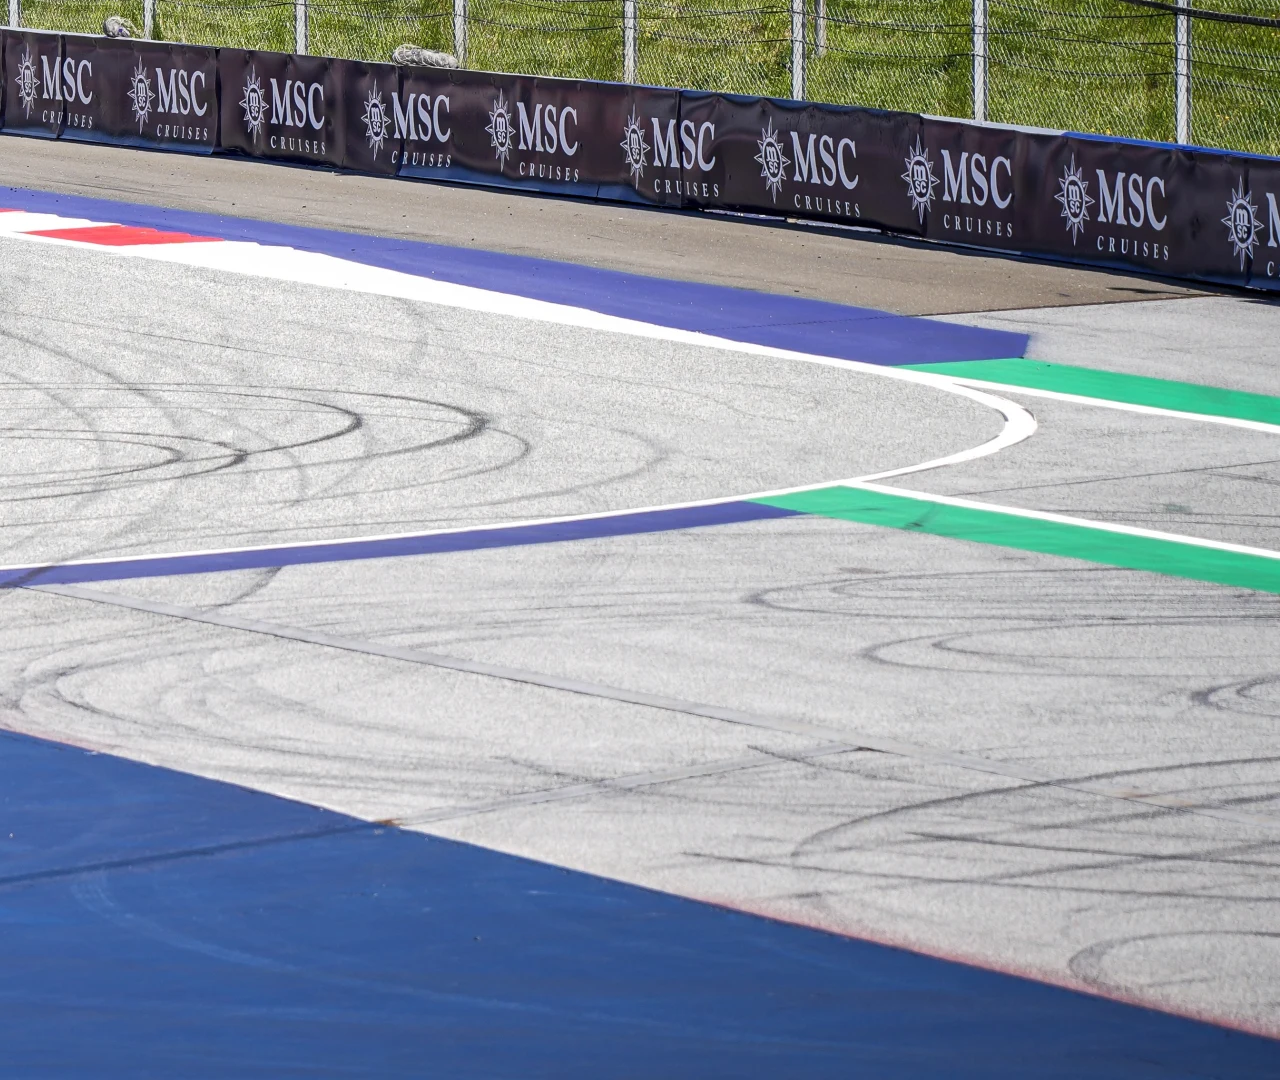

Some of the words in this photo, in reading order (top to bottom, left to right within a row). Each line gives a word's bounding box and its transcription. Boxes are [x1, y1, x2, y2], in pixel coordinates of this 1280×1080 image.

[41, 55, 93, 105] MSC
[155, 67, 207, 116] MSC
[42, 109, 94, 129] CRUISES
[270, 77, 325, 130] MSC
[391, 92, 451, 143] MSC
[157, 124, 209, 141] CRUISES
[270, 135, 326, 155] CRUISES
[516, 101, 578, 156] MSC
[651, 117, 716, 172] MSC
[391, 150, 451, 168] CRUISES
[519, 161, 579, 183] CRUISES
[790, 131, 859, 190] MSC
[654, 178, 719, 198] CRUISES
[940, 149, 1012, 209] MSC
[793, 193, 861, 218] CRUISES
[1096, 168, 1168, 231] MSC
[944, 213, 1013, 238] CRUISES
[1097, 235, 1170, 260] CRUISES
